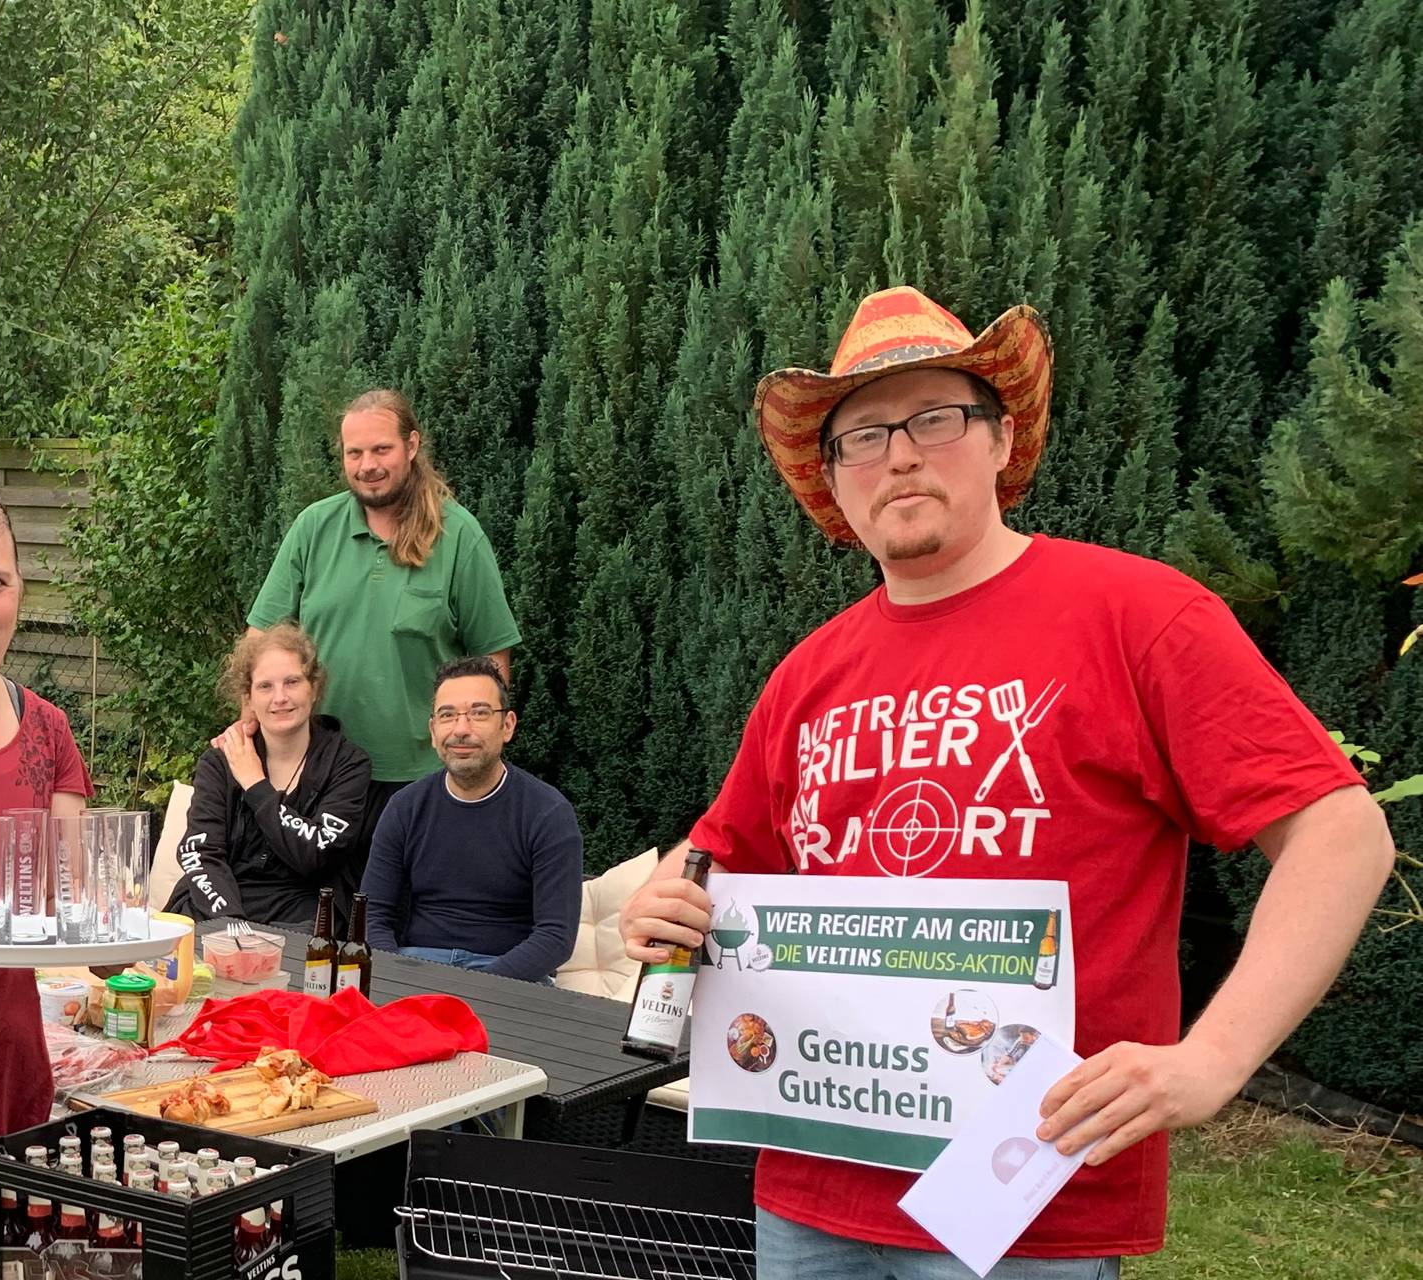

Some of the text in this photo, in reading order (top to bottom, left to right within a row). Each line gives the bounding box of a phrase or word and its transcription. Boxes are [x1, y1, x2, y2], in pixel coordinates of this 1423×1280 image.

[797, 684, 986, 758] AUFTRAGS
[791, 788, 820, 834] AM
[19, 856, 33, 916] VELTINS
[766, 911, 1034, 944] WER REGIERT AM GRILL?
[775, 943, 1034, 976] DIE VELTINS GENUSS-AKTION
[642, 998, 683, 1018] VELTINS
[798, 1029, 929, 1073] Genuss
[778, 1069, 952, 1123] Gutschein
[246, 1254, 276, 1280] VELTINS
